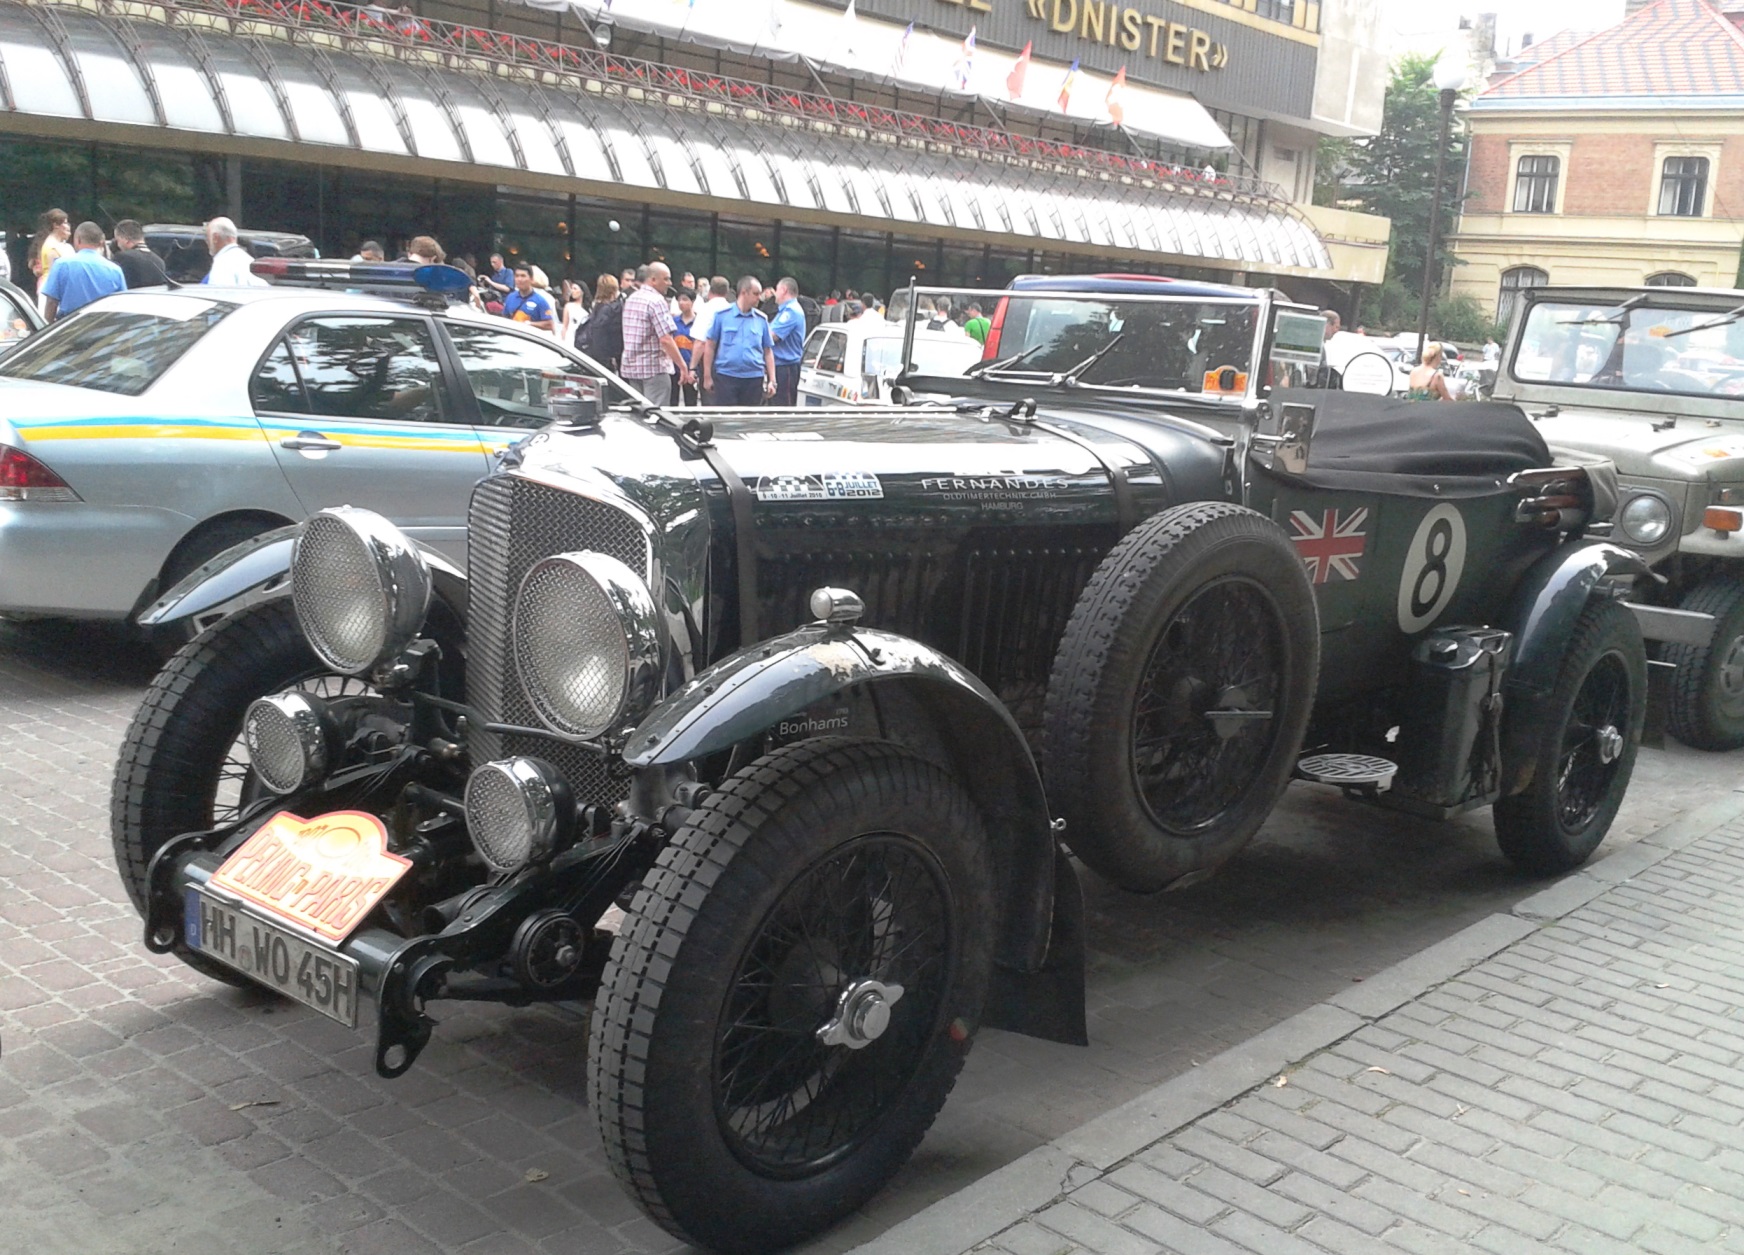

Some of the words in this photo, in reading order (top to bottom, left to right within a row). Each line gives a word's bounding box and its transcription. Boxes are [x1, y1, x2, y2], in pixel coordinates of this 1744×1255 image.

[845, 481, 878, 489] JUILLET
[921, 478, 1069, 490] FERNANDES
[790, 492, 808, 500] Juillet
[846, 489, 882, 497] 2012
[981, 502, 1024, 511] HAMBURG
[1410, 517, 1453, 619] 8
[780, 717, 849, 736] Bonhams
[222, 827, 312, 901] PEKING
[289, 869, 391, 931] PARIS
[201, 901, 236, 960] HH
[253, 925, 290, 985] WO
[297, 950, 352, 1019] 45H
